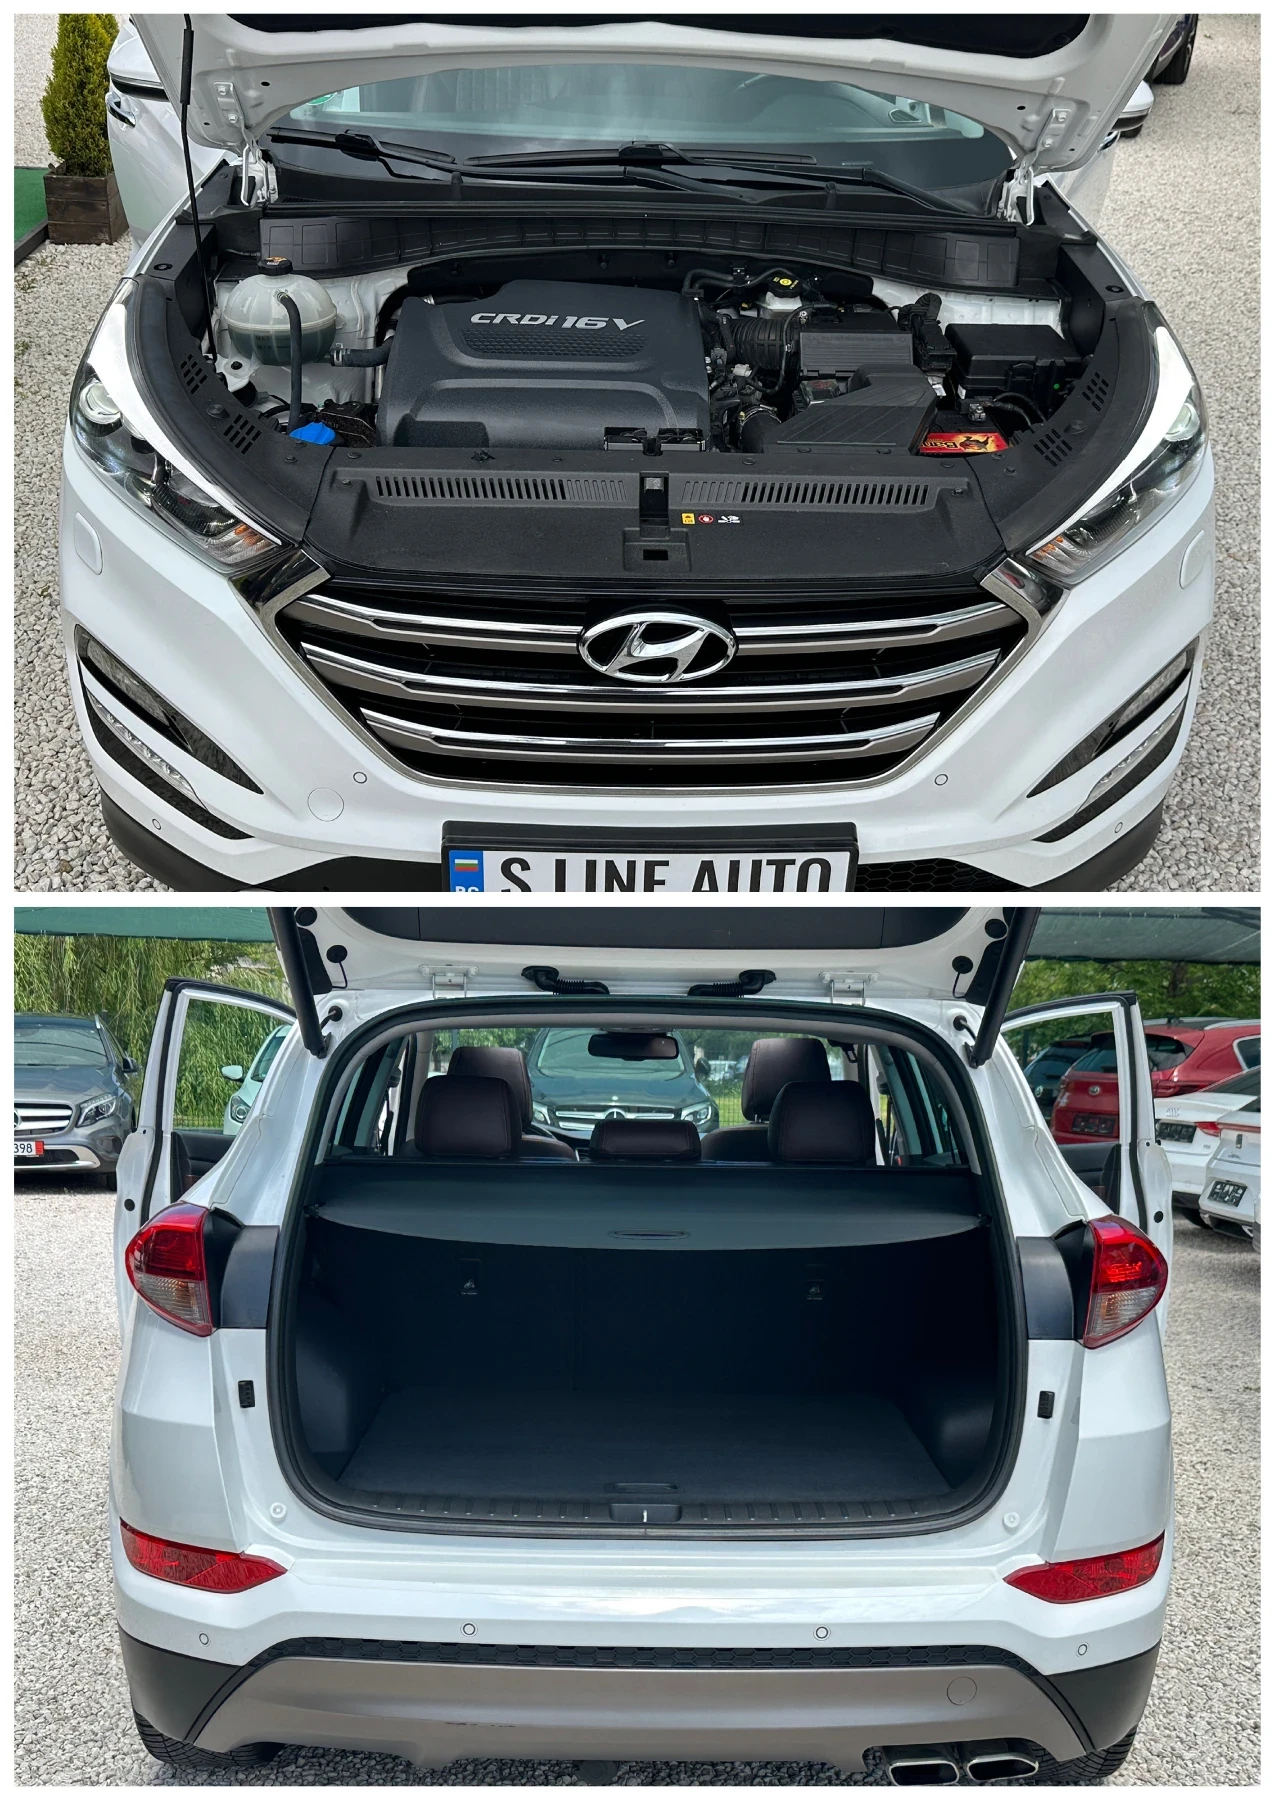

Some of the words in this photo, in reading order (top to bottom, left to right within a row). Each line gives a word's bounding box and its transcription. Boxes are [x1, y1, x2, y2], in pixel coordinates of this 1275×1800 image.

[561, 315, 646, 331] 16V
[691, 857, 832, 892] AUTO
[14, 1142, 33, 1154] 398
